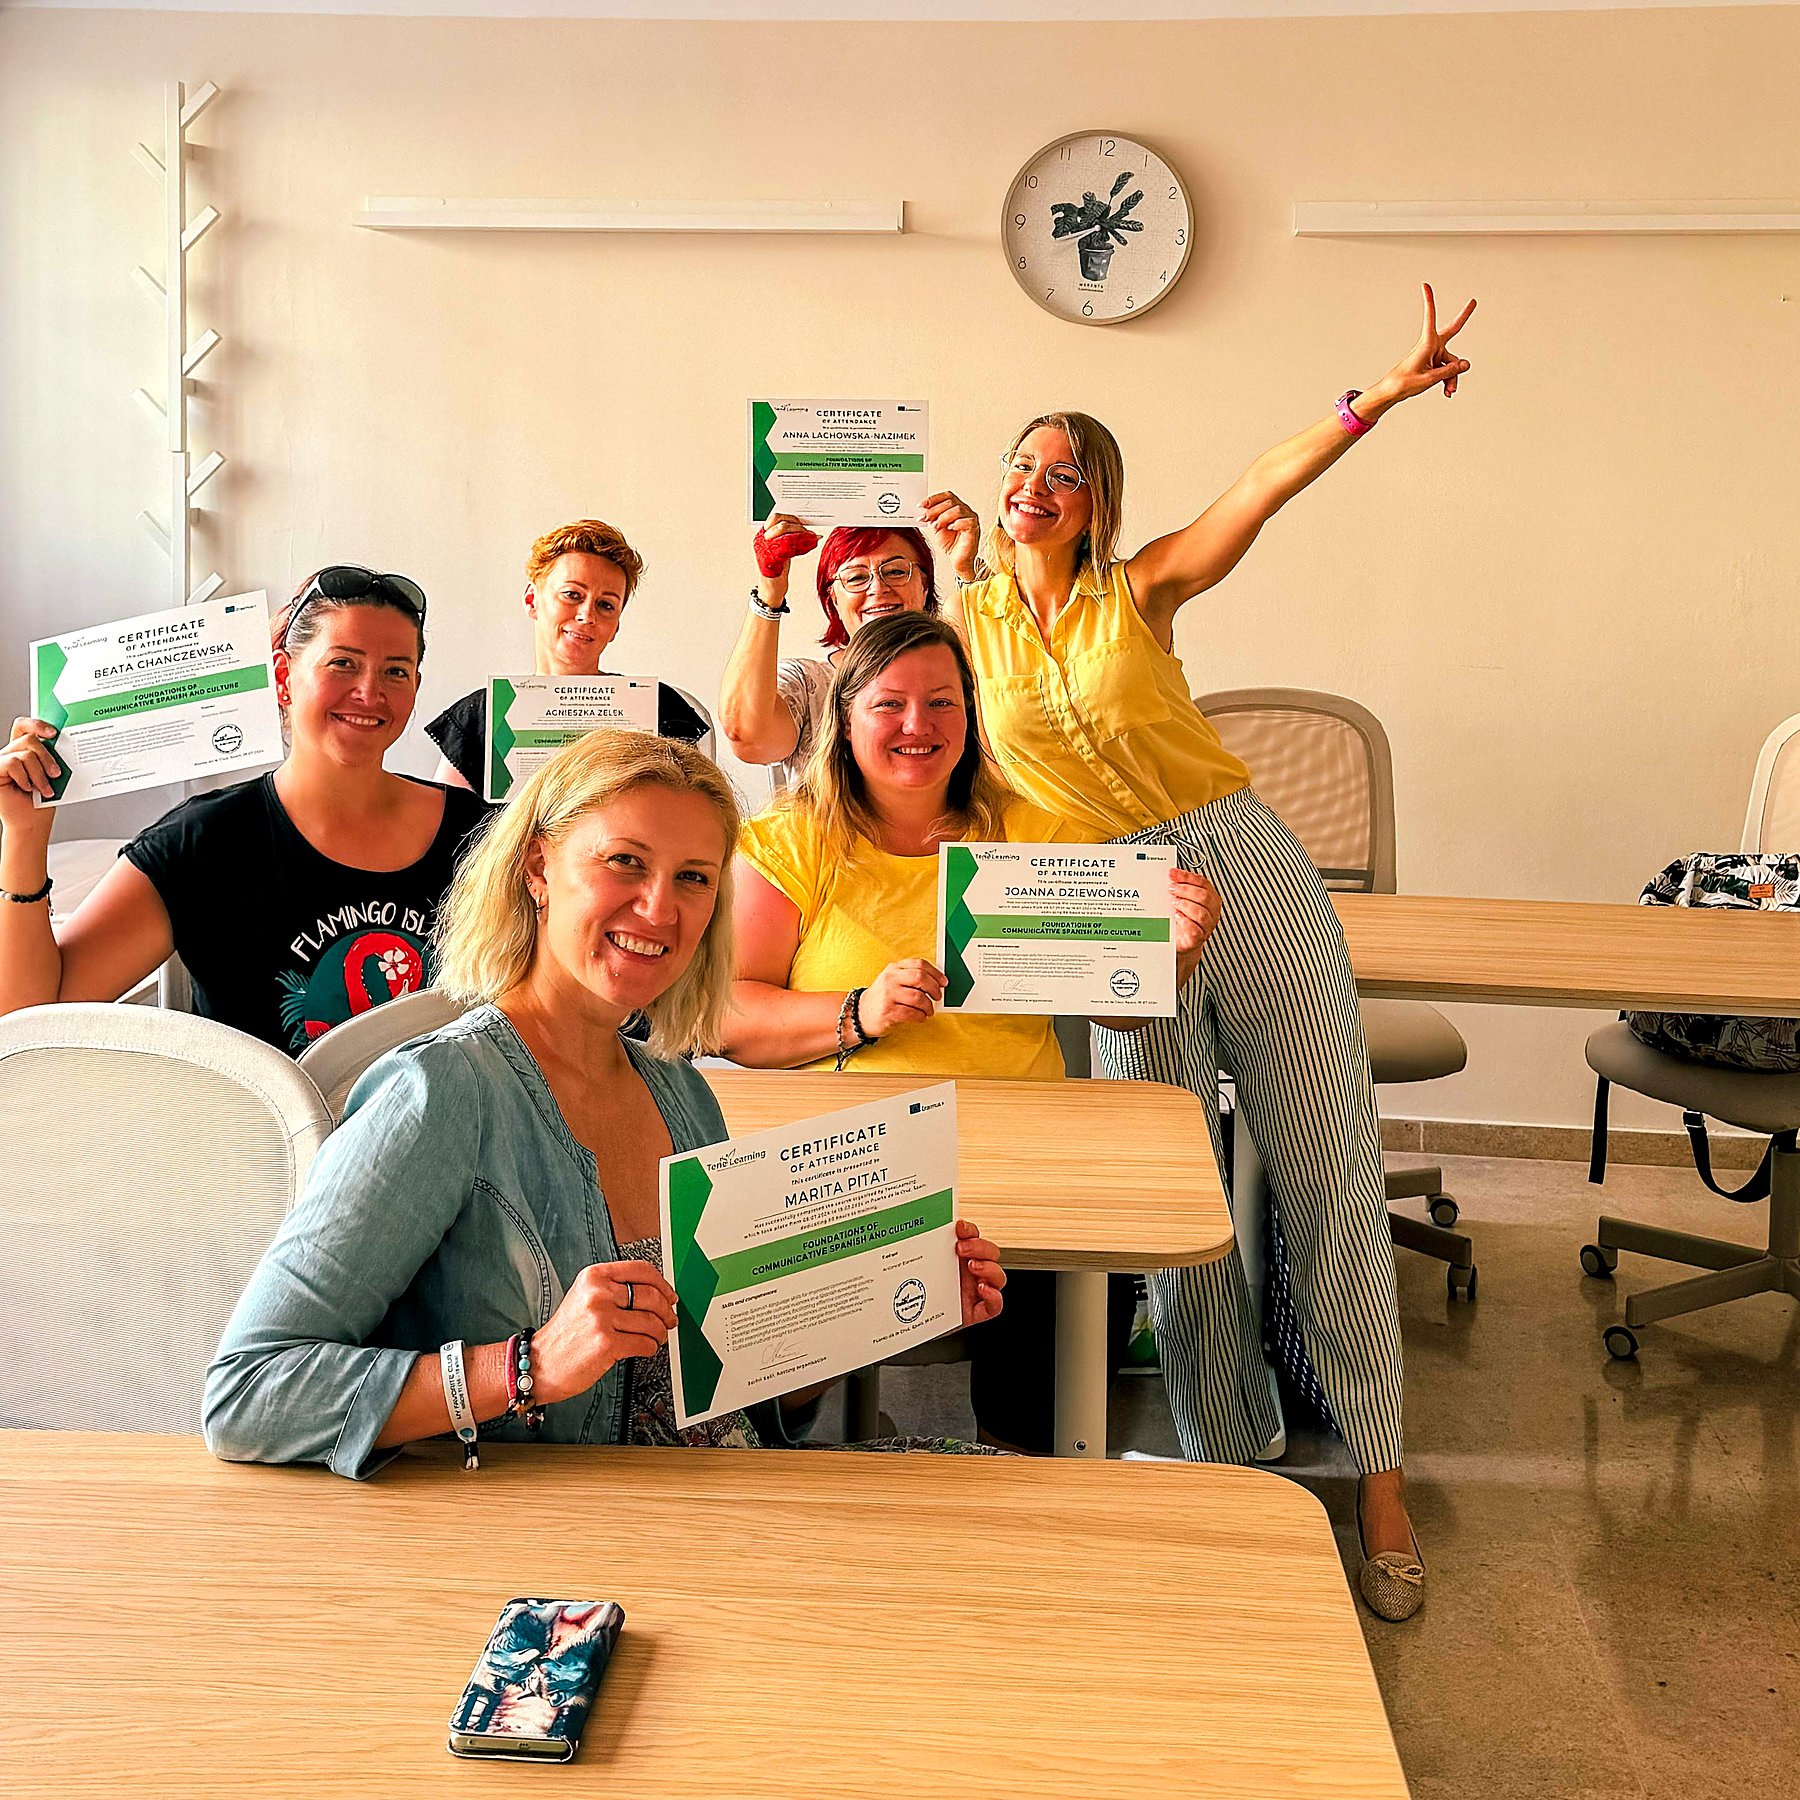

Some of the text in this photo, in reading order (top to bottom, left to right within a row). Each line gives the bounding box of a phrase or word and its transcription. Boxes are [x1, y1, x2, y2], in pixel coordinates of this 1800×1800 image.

[1061, 147, 1071, 160] 11
[1100, 140, 1116, 156] 12
[1024, 175, 1038, 188] 10
[1169, 187, 1177, 199] 2
[1015, 214, 1026, 230] 9
[1175, 229, 1185, 245] 3
[1018, 257, 1027, 269] 8
[1160, 271, 1166, 282] 4
[1046, 289, 1054, 300] 7
[1126, 296, 1134, 308] 5
[1082, 301, 1093, 316] 6
[812, 432, 916, 440] LACHOWSKA-NAZIMEK
[118, 619, 205, 644] CERTIFICATE
[140, 632, 199, 648] ATTENDANCE
[94, 663, 132, 678] BEATA
[137, 642, 233, 669] CHANCZEWSKA
[93, 682, 238, 715] COMMUNICATIVE SPANISH AND CULTURE
[134, 682, 198, 700] FOUNDATIONS OF
[1031, 859, 1116, 868] CERTIFICATE
[1004, 887, 1140, 898] JOANNA DZIEWOŃSKA
[291, 901, 426, 962] FLAMINGO ISL
[779, 1123, 886, 1161] CERTIFICATE
[729, 1149, 766, 1166] Learning
[790, 1142, 880, 1174] OF ATTENDANCE
[791, 1177, 804, 1186] This
[804, 1168, 835, 1183] certificate
[785, 1167, 888, 1209] MARITA PITAT
[802, 1221, 878, 1251] FOUNDATIONS OF
[751, 1217, 924, 1276] COMMUNICATIVE SPANISH AND CULTURE
[448, 1374, 459, 1409] FAVORITE
